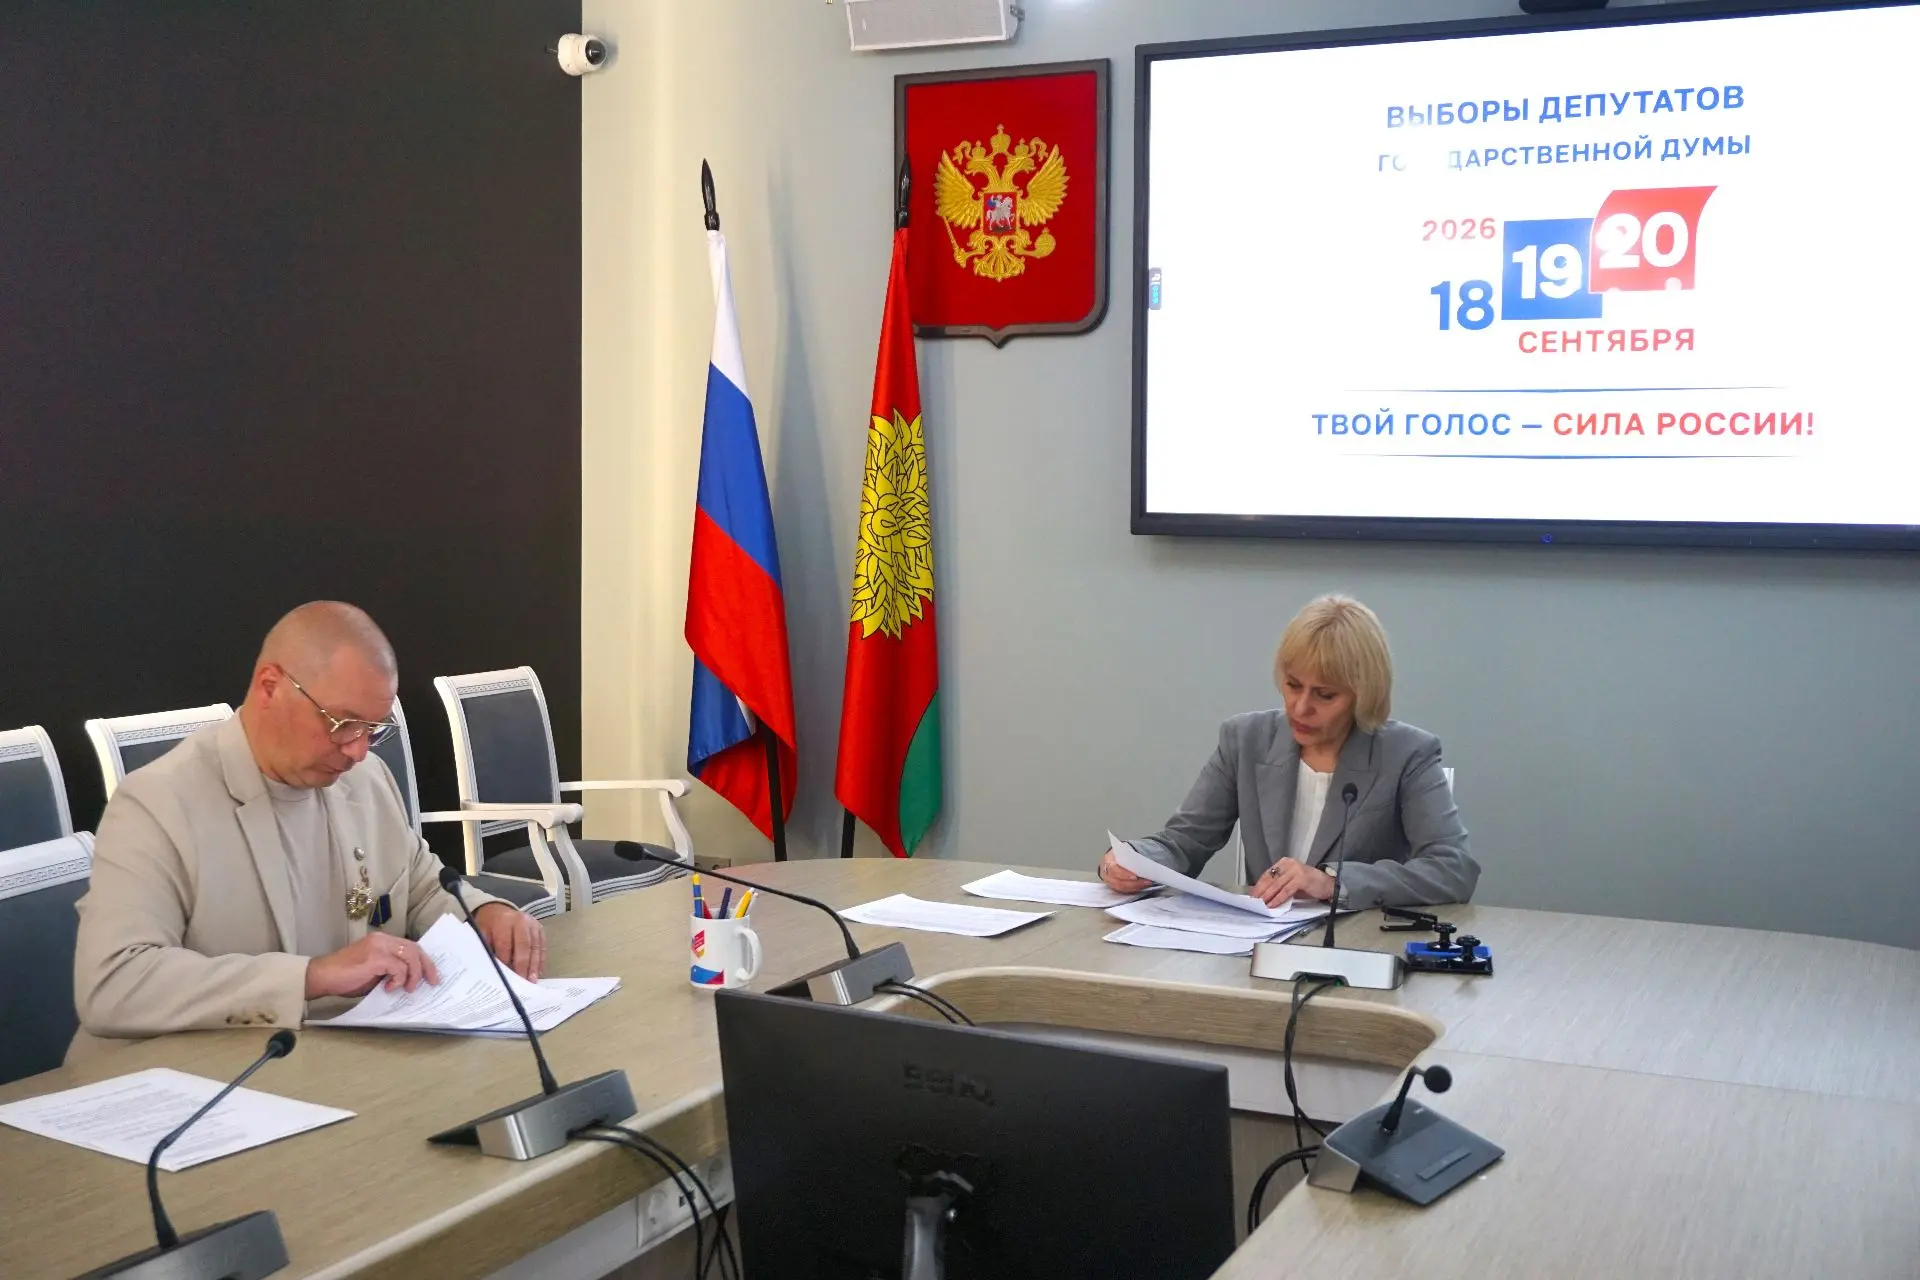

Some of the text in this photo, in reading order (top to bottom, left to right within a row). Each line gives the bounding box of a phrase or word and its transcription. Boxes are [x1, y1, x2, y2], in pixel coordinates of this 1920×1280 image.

[1387, 85, 1745, 128] ВЫБОРЫ ДЕПУТАТОВ
[1378, 134, 1751, 171] ГОДАРСТВЕННОЙ ДУМЫ
[1422, 217, 1496, 241] 2026
[1595, 211, 1689, 269] 20
[1512, 243, 1583, 299] 19
[1430, 279, 1495, 331] 18
[1518, 328, 1695, 354] СЕНТЯБРЯ
[1312, 408, 1394, 436] ТВОЙ
[1405, 412, 1511, 436] ГОЛОС
[1553, 412, 1645, 436] СИЛА
[1657, 412, 1814, 436] РОССИИ!
